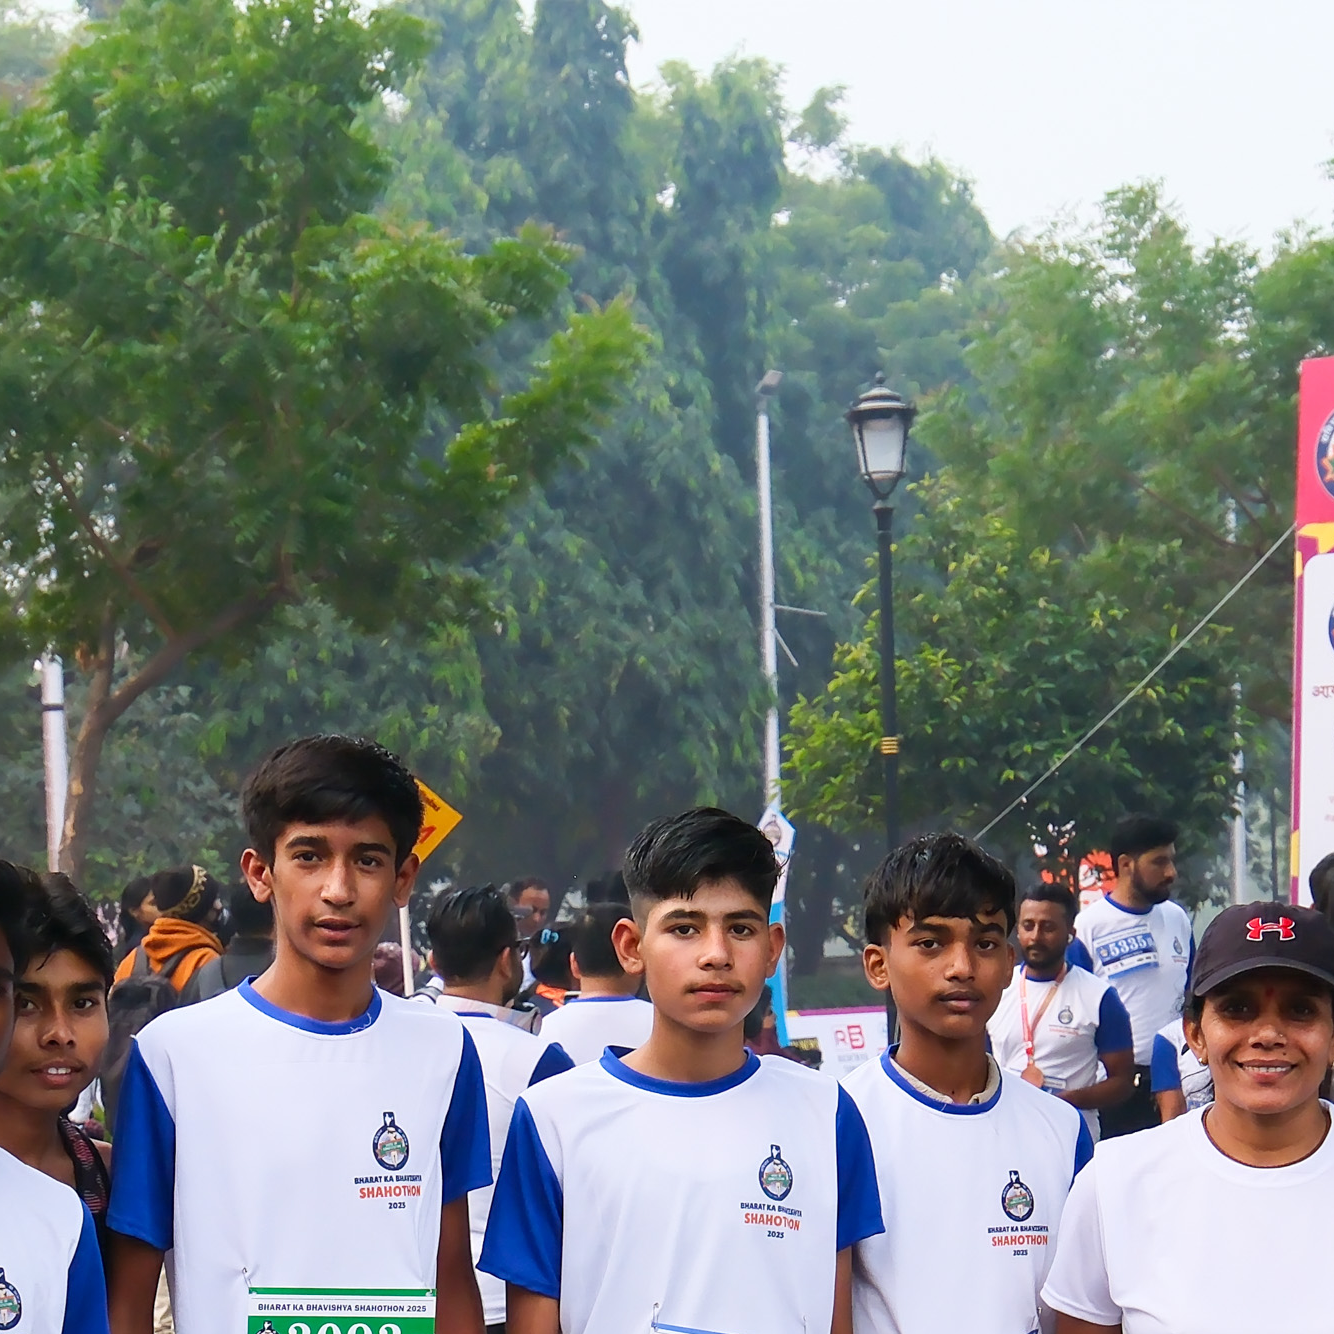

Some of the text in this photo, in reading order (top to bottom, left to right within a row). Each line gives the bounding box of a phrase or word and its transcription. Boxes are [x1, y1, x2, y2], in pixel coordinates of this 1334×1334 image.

[1109, 935, 1147, 957] 5335
[360, 1185, 420, 1199] SHAHOTHON
[992, 1235, 1048, 1246] SHAHOTHON
[306, 1304, 352, 1312] BHAVISHYA
